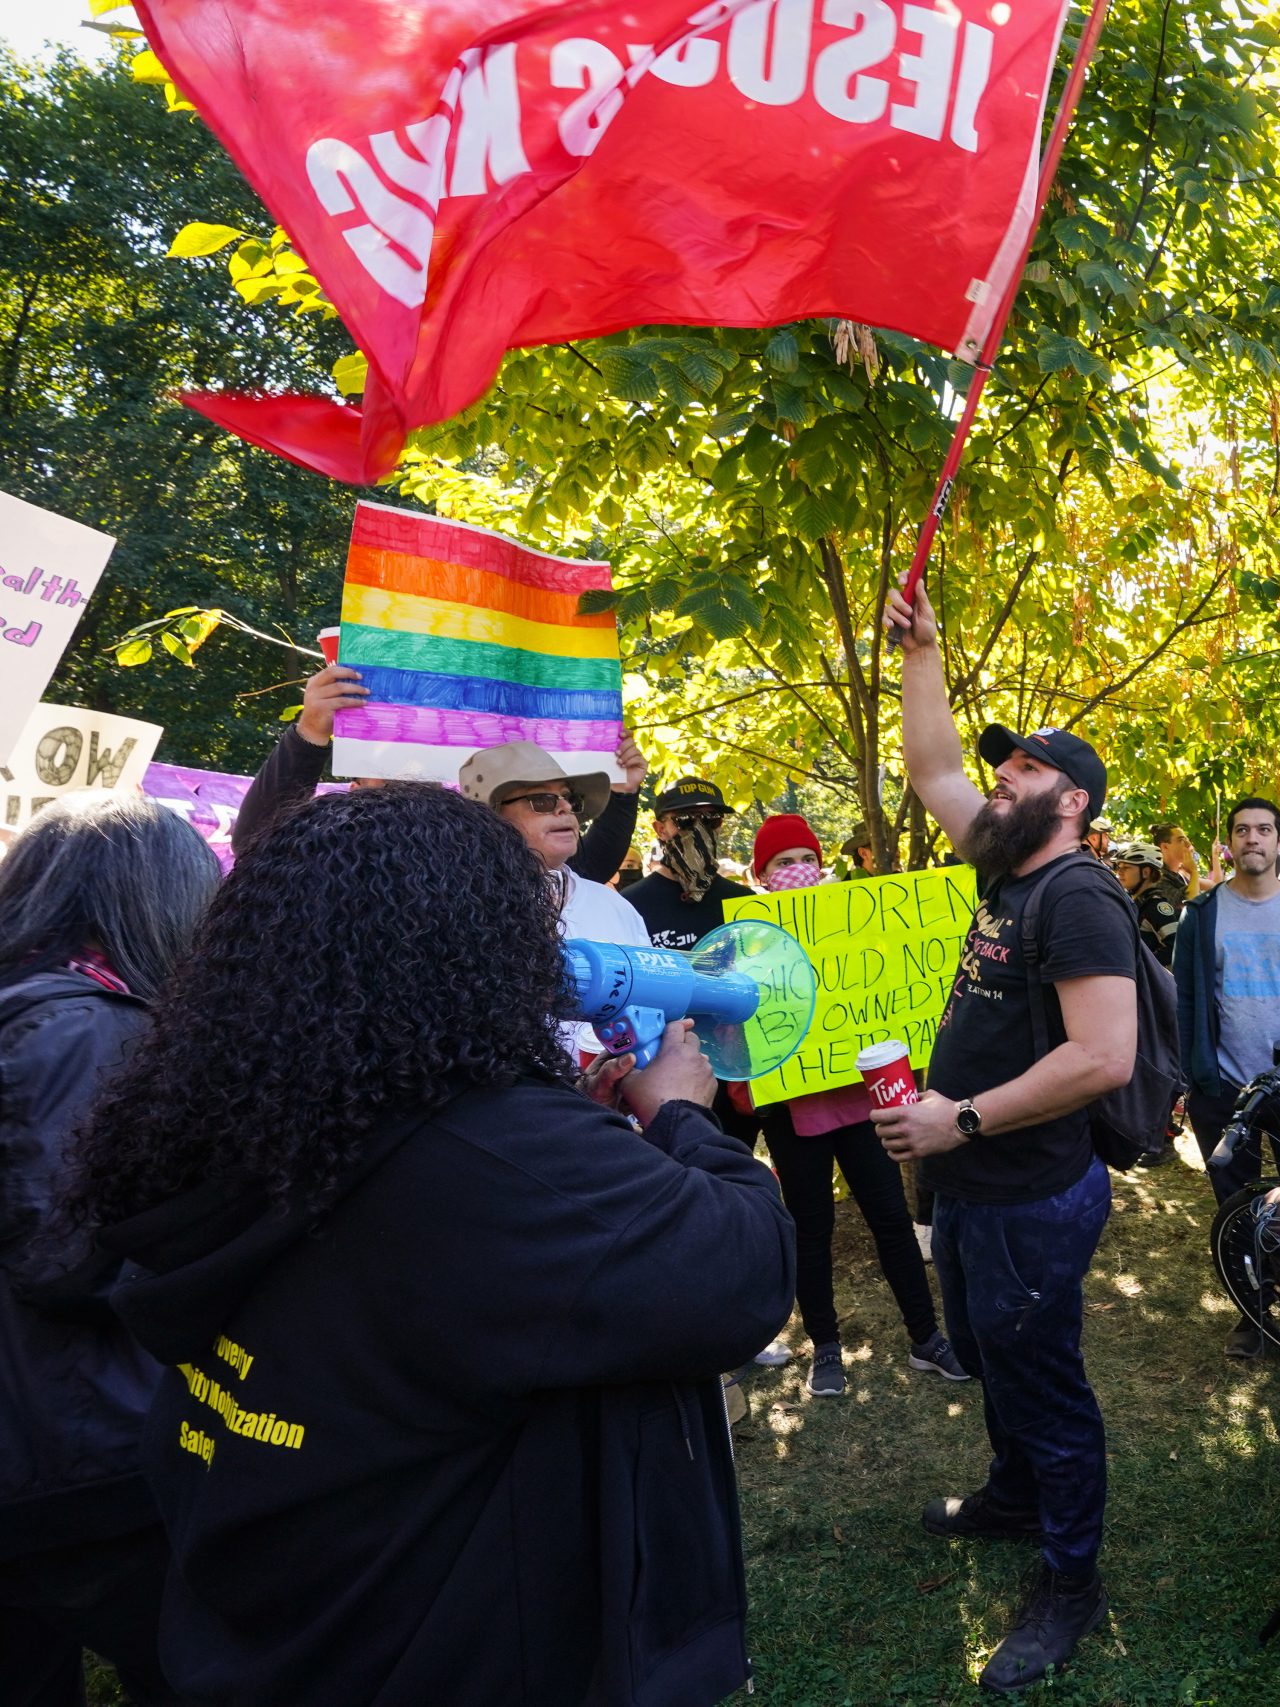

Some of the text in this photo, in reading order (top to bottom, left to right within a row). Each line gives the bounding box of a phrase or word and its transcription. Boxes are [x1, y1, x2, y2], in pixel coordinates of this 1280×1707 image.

[679, 784, 697, 795] TOP
[733, 875, 978, 958] CHILDREN
[635, 951, 678, 968] PYLE
[903, 934, 967, 984] NOT
[822, 981, 933, 1032] OWNED
[868, 1077, 907, 1106] Tim
